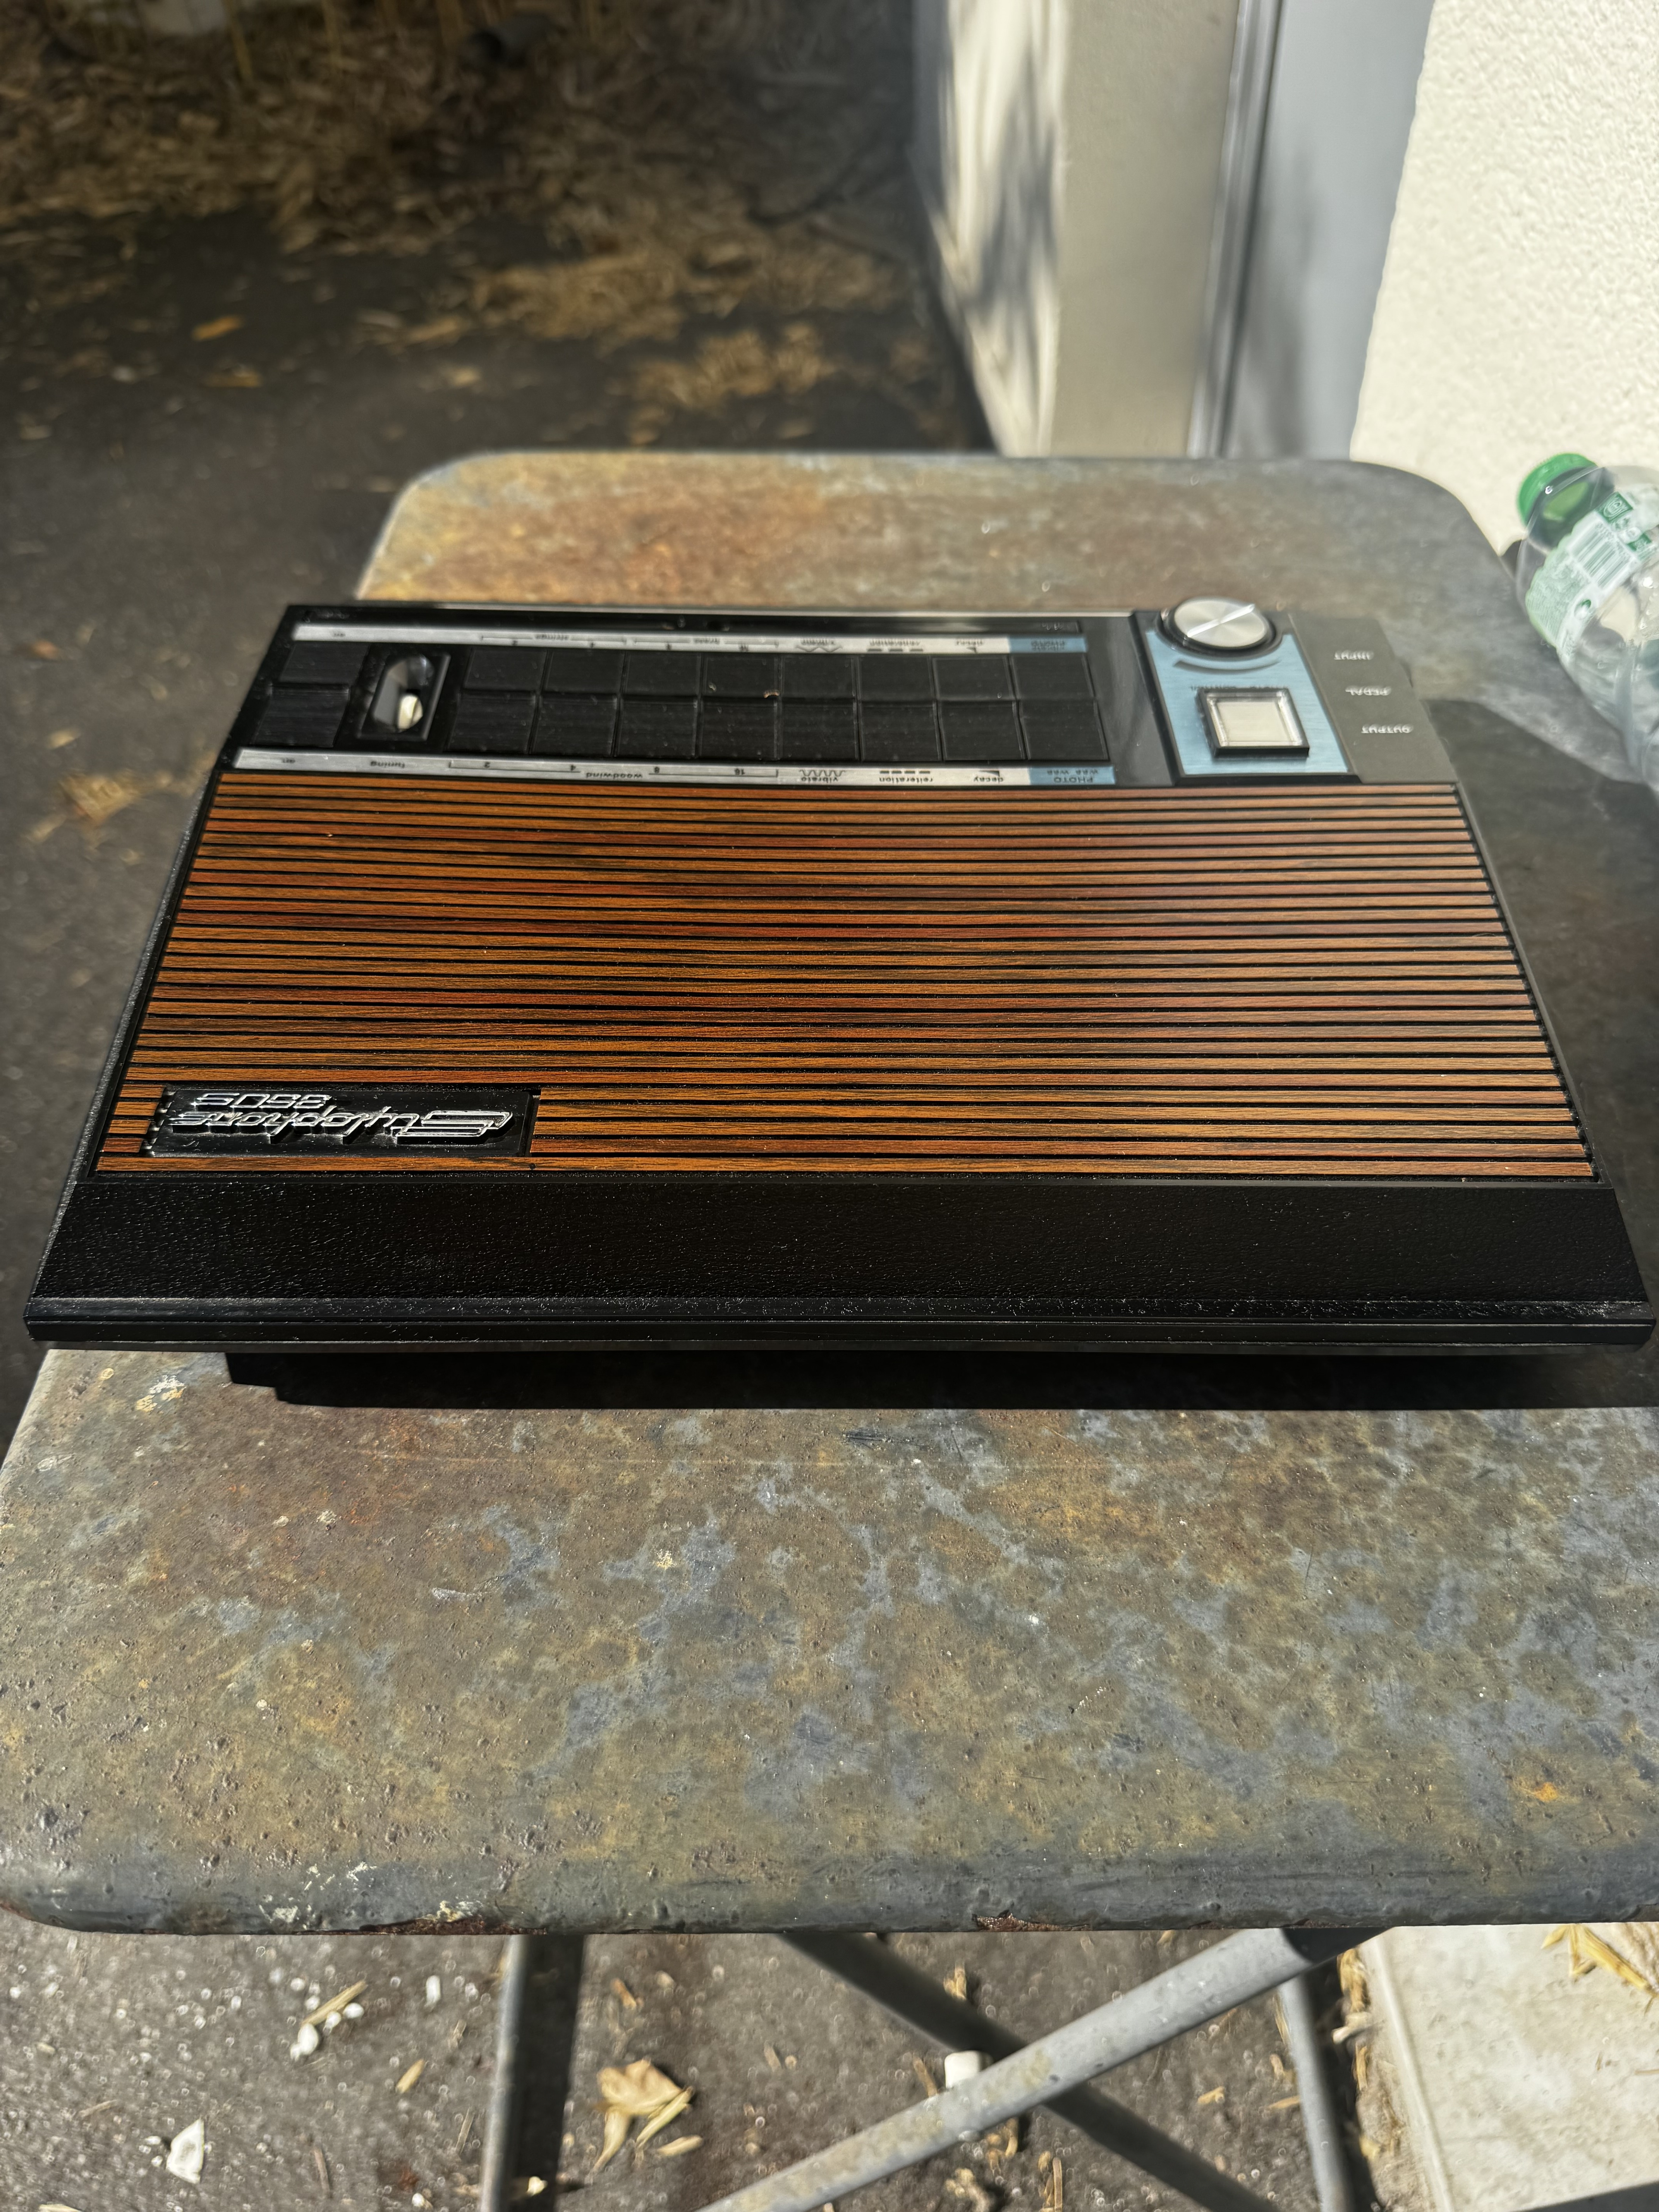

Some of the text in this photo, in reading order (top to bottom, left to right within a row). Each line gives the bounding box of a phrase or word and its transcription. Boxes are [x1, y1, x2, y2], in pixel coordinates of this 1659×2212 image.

[1334, 650, 1374, 660] INPUT
[1345, 686, 1391, 696] PEDAL
[1362, 724, 1413, 733] OUTPUT
[169, 1106, 513, 1137] Stylophone
